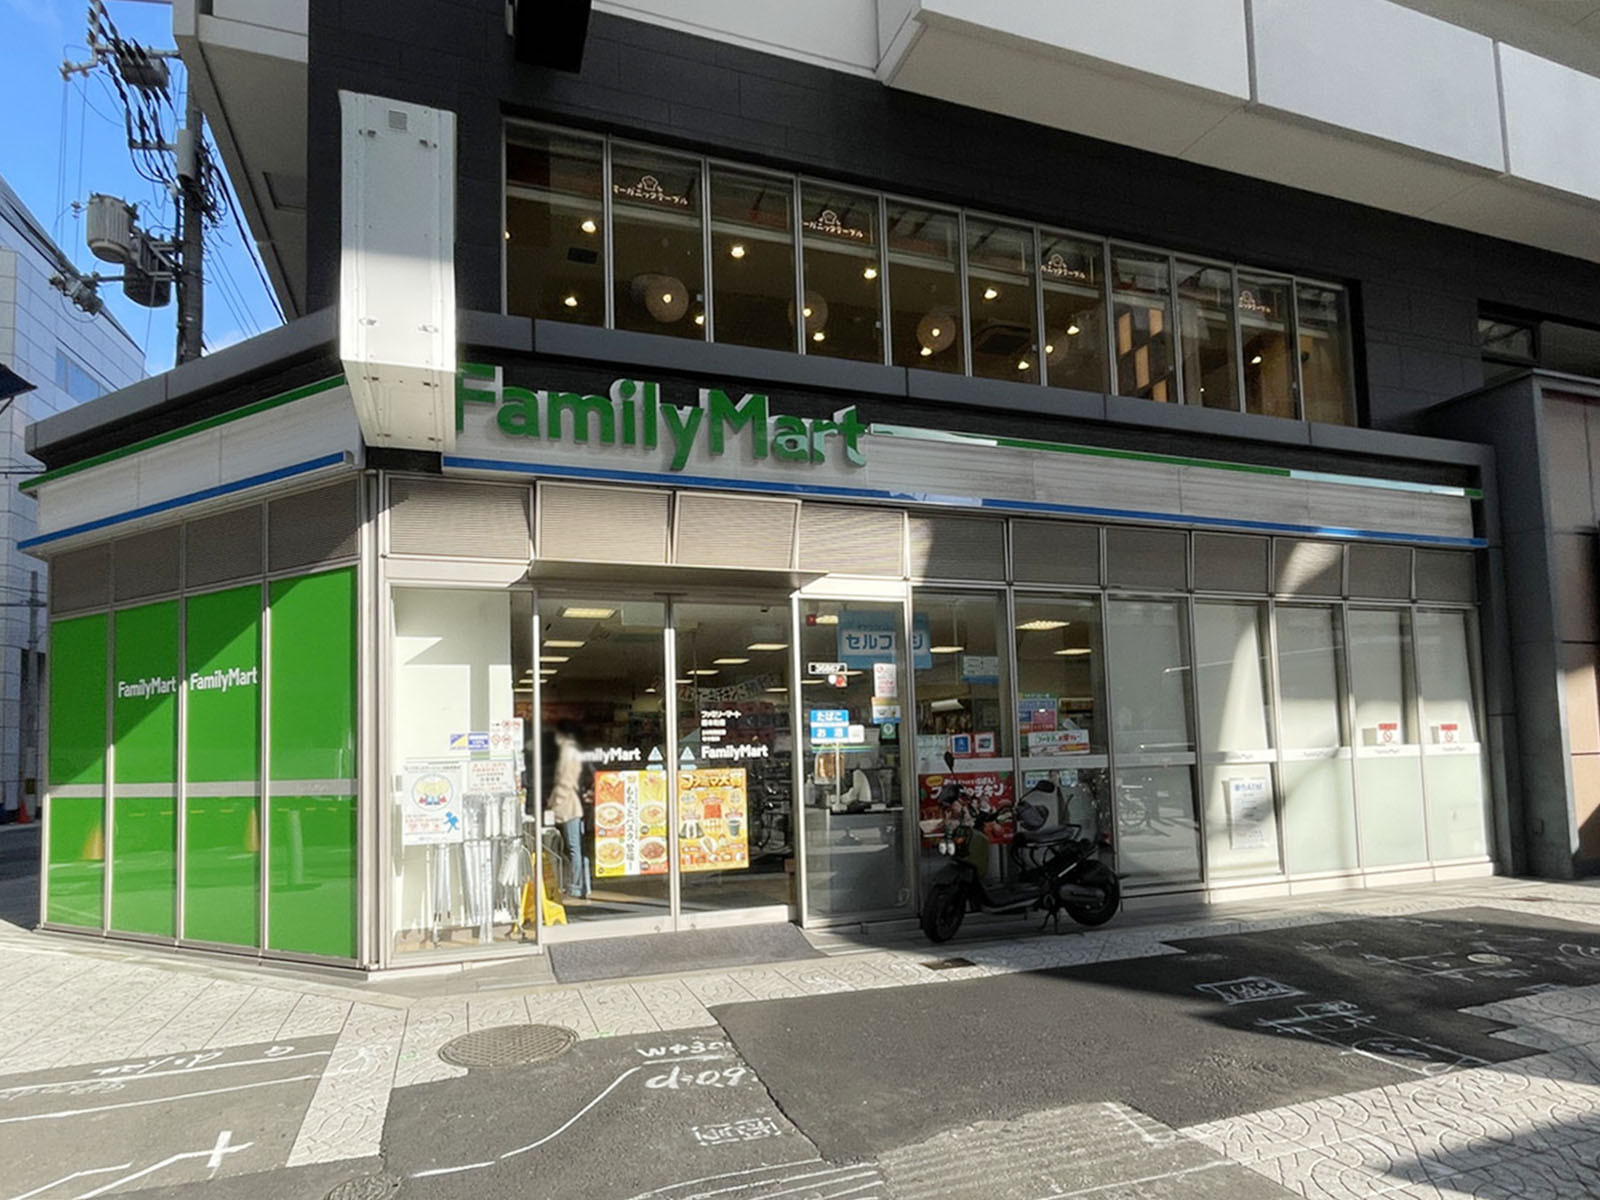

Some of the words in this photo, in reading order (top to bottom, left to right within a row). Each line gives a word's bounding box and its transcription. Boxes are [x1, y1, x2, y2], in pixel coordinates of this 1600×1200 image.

[456, 362, 867, 472] FamilyMart
[845, 633, 923, 650] セルフジ
[118, 676, 177, 700] FamilyMart
[190, 666, 258, 692] FamilyMart
[575, 747, 641, 765] amilyMart
[701, 744, 768, 761] FamilyMart
